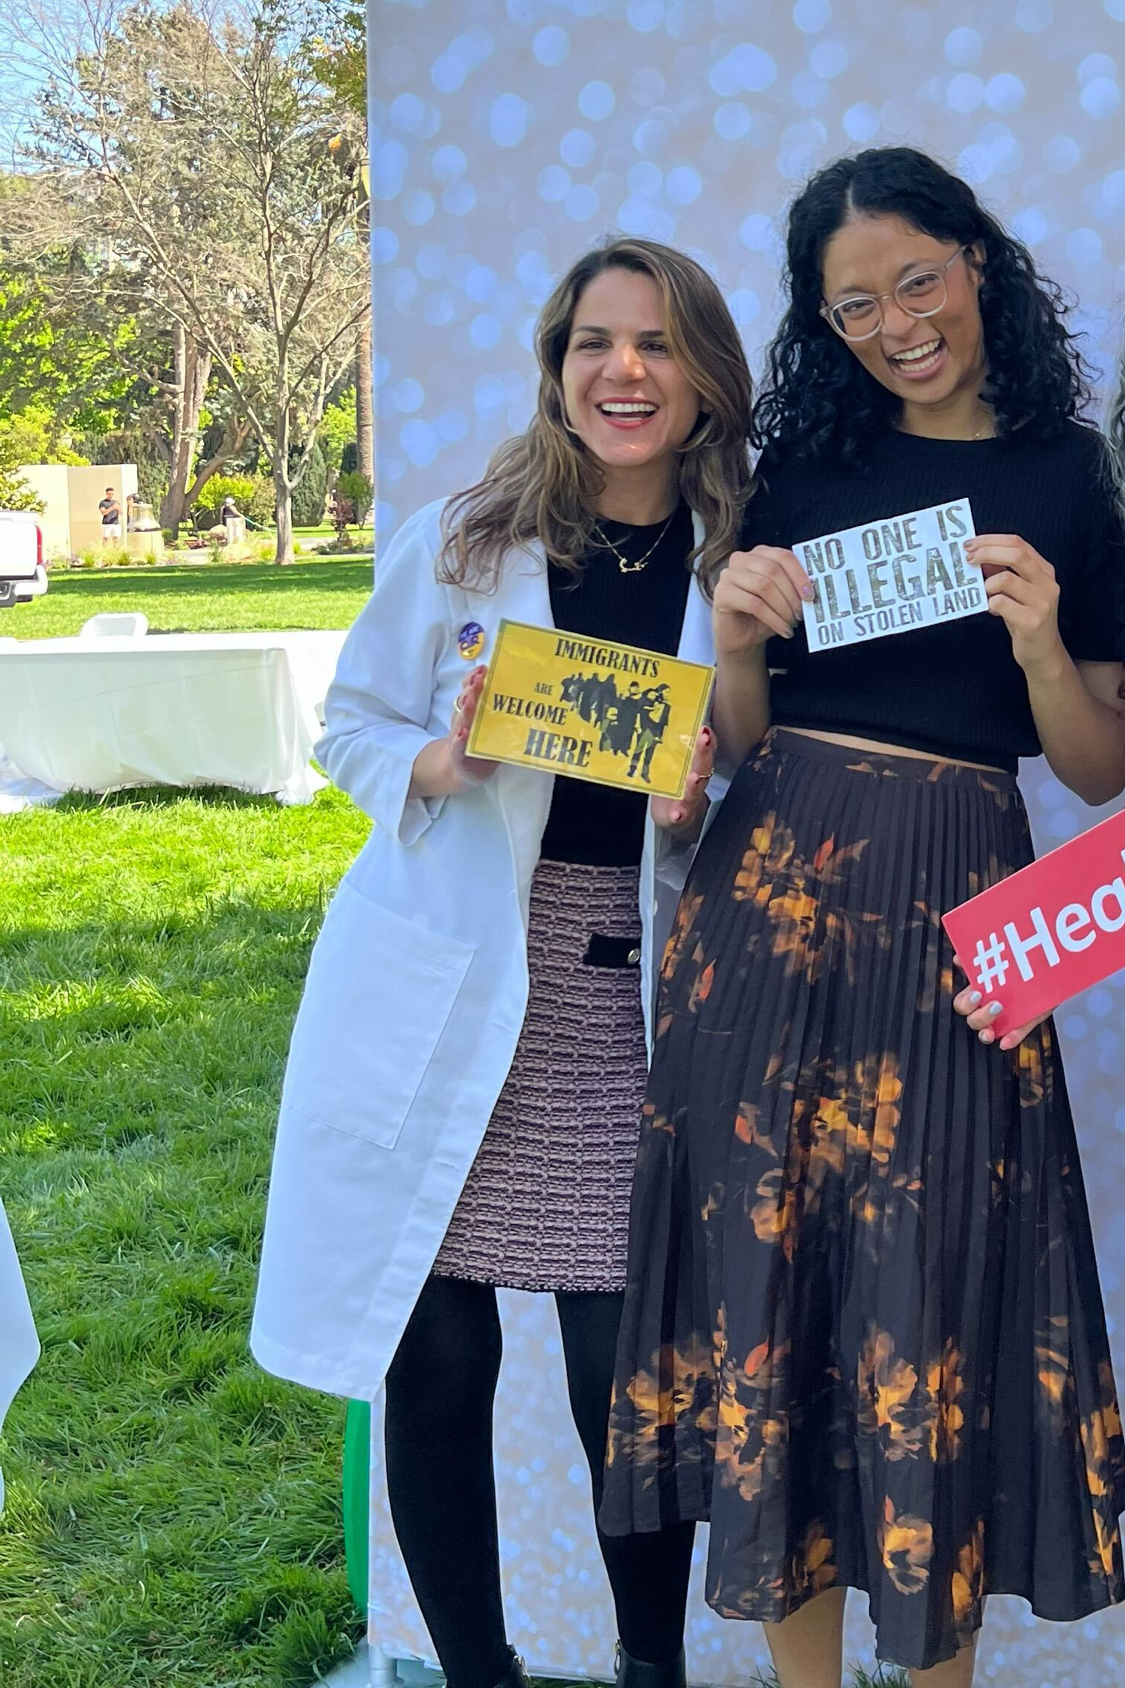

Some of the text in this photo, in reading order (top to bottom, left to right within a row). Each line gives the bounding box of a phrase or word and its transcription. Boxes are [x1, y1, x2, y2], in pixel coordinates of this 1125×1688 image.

[803, 505, 968, 576] NO ONE IS
[811, 541, 978, 624] ILLEGAL
[818, 587, 982, 645] ON STOLEN LAND
[554, 637, 661, 678] IMMIGRANTS
[533, 681, 554, 696] ARE
[492, 693, 568, 726] WELCOME
[523, 728, 593, 768] HERE
